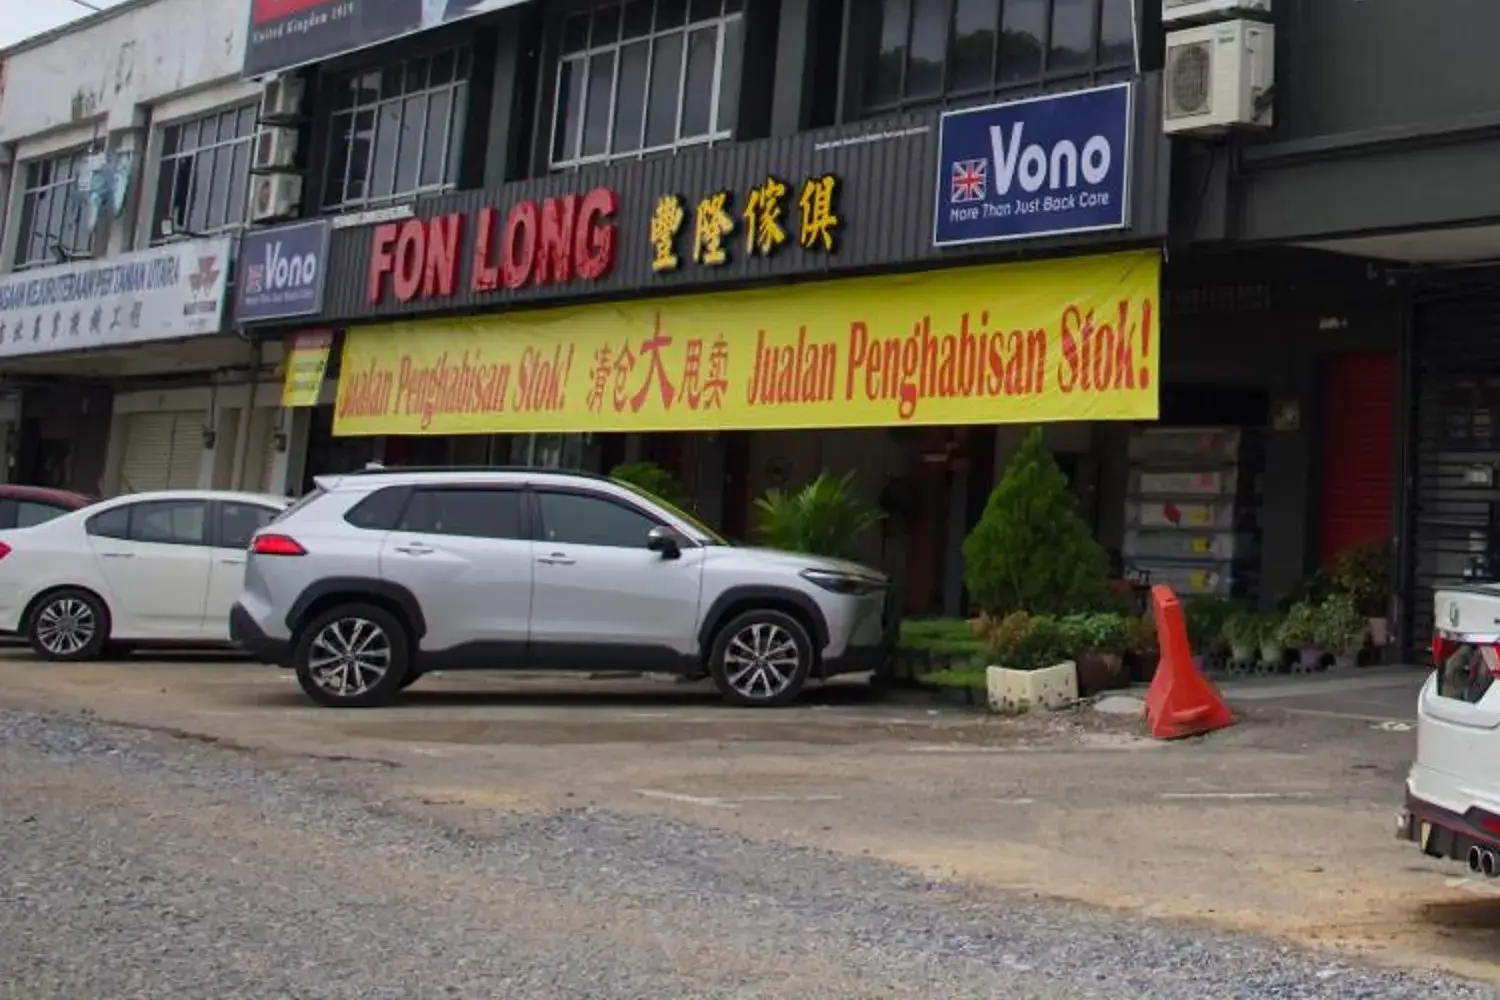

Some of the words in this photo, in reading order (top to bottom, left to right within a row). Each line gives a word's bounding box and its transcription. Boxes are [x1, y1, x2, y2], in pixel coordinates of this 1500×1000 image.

[989, 121, 1111, 195] Vono
[368, 213, 463, 304] FON
[472, 187, 617, 292] LONG
[950, 206, 979, 223] More
[983, 202, 1011, 217] Than
[1014, 199, 1040, 214] Just
[1043, 194, 1075, 212] Back
[1078, 191, 1109, 208] Care
[265, 241, 317, 290] Vono
[394, 347, 511, 430] Penghabisan
[513, 342, 576, 413] Stok!
[586, 308, 730, 414] 清仓大甩卖
[748, 324, 837, 406] Jualan
[845, 310, 1047, 420] Penghabisan
[1057, 297, 1153, 393] Stok!
